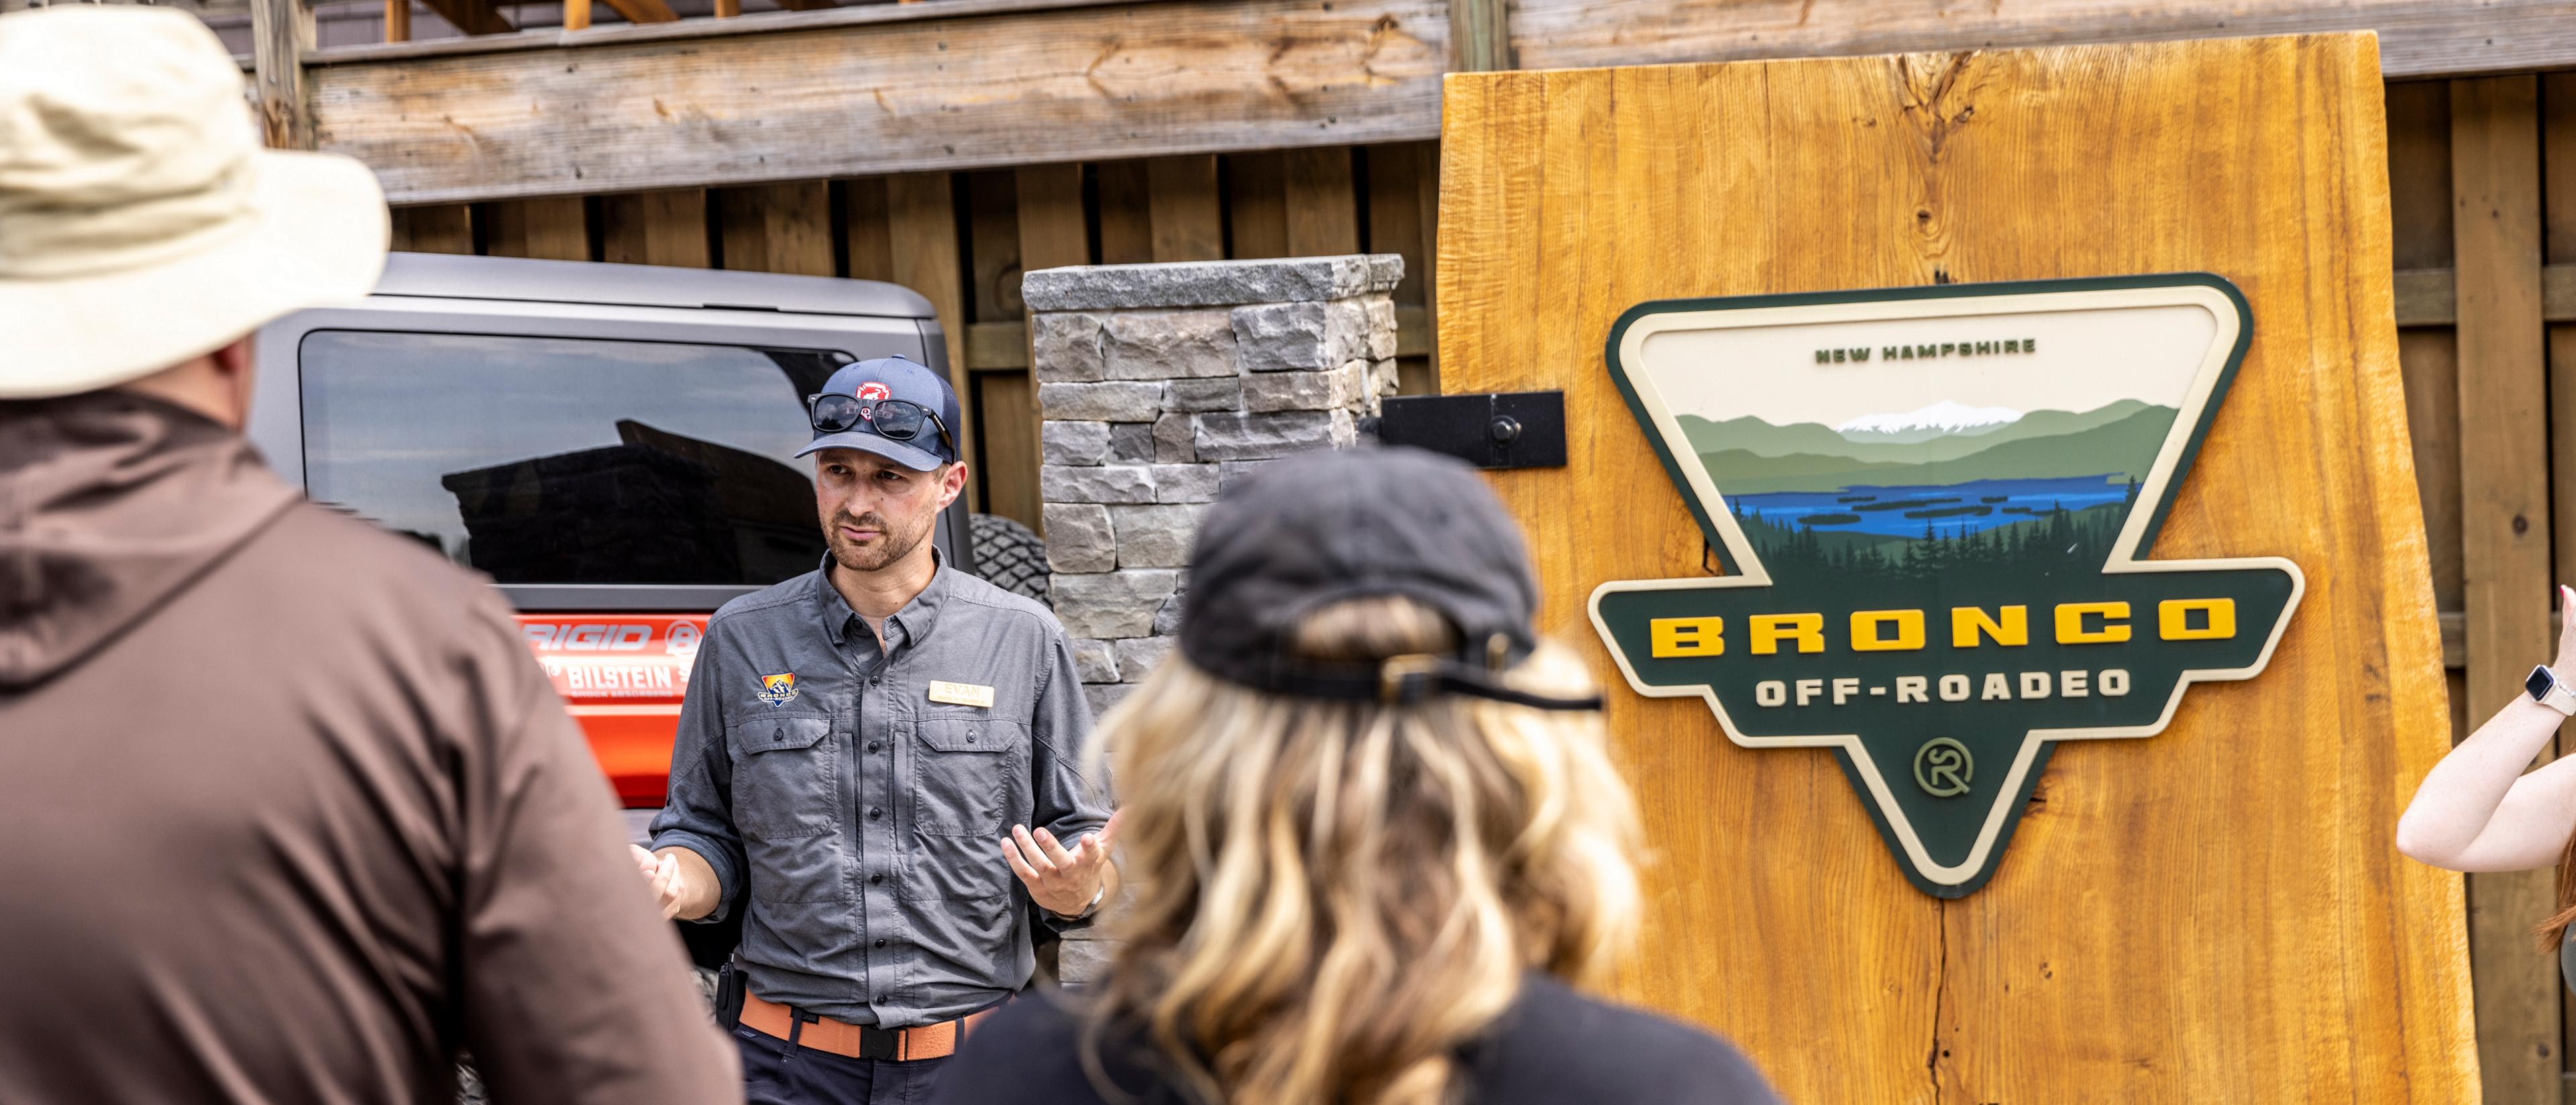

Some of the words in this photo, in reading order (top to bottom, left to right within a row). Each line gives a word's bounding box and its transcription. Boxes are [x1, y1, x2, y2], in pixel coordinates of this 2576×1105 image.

[1815, 348, 1870, 364] NEW
[1882, 337, 2035, 361] HAMPSHIRE
[523, 623, 653, 651] RIGID
[1650, 598, 2237, 658] BRONCO
[567, 666, 672, 689] BILSTEIN
[1755, 669, 2131, 707] OFF-ROADEO
